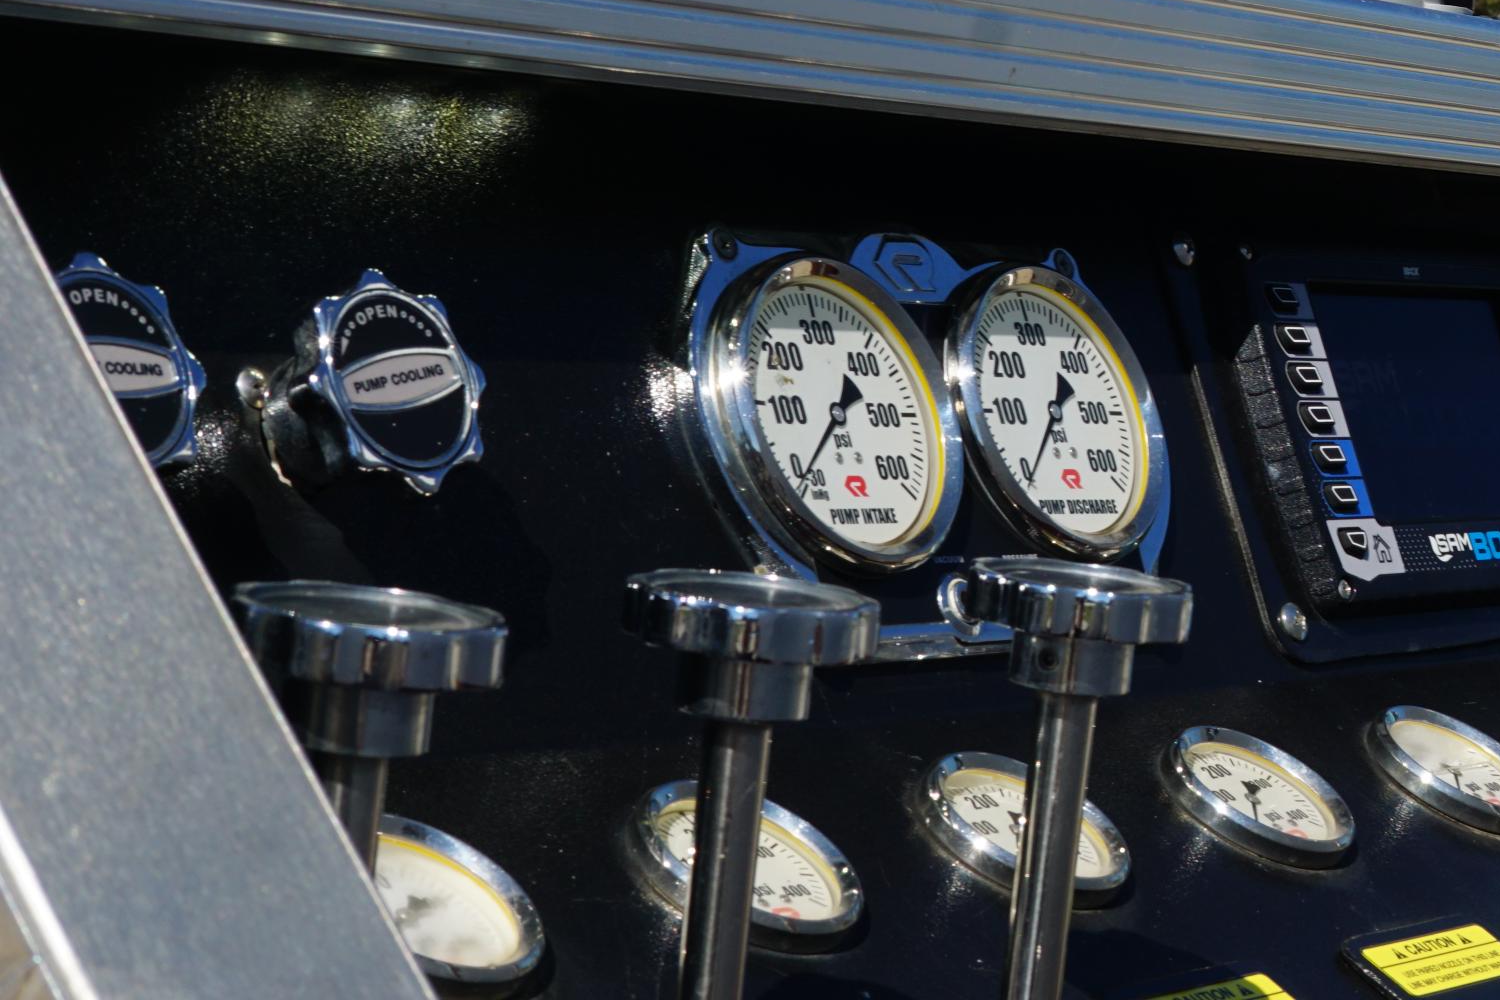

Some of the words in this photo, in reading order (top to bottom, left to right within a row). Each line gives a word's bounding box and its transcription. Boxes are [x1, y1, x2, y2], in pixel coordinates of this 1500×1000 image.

[69, 288, 119, 307] OPEN
[355, 304, 398, 326] OPEN
[799, 319, 836, 346] 300
[1013, 321, 1046, 347] 300
[761, 341, 804, 372] 200
[847, 350, 881, 378] 400
[988, 350, 1026, 379] 200
[1060, 350, 1089, 375] 400
[104, 361, 163, 377] COOLING
[353, 375, 388, 394] PUMP
[390, 364, 444, 386] COOLING
[767, 394, 808, 425] 100
[865, 402, 901, 428] 500
[992, 397, 1028, 425] 100
[1077, 400, 1109, 425] 500
[832, 430, 853, 449] psi
[1051, 428, 1068, 445] psi
[789, 452, 806, 480] 0
[874, 455, 910, 481] 600
[1019, 457, 1034, 483] 0
[1087, 449, 1117, 473] 600
[829, 507, 860, 525] PUMP
[862, 508, 899, 525] INTAKE
[1039, 499, 1066, 515] PUMP
[1068, 500, 1119, 515] DISCHARGE
[1201, 763, 1232, 779] 200
[964, 794, 999, 810] 200
[1212, 788, 1236, 802] 00
[1286, 808, 1309, 820] 400
[971, 820, 999, 835] 00
[1404, 936, 1457, 956] CAUTION
